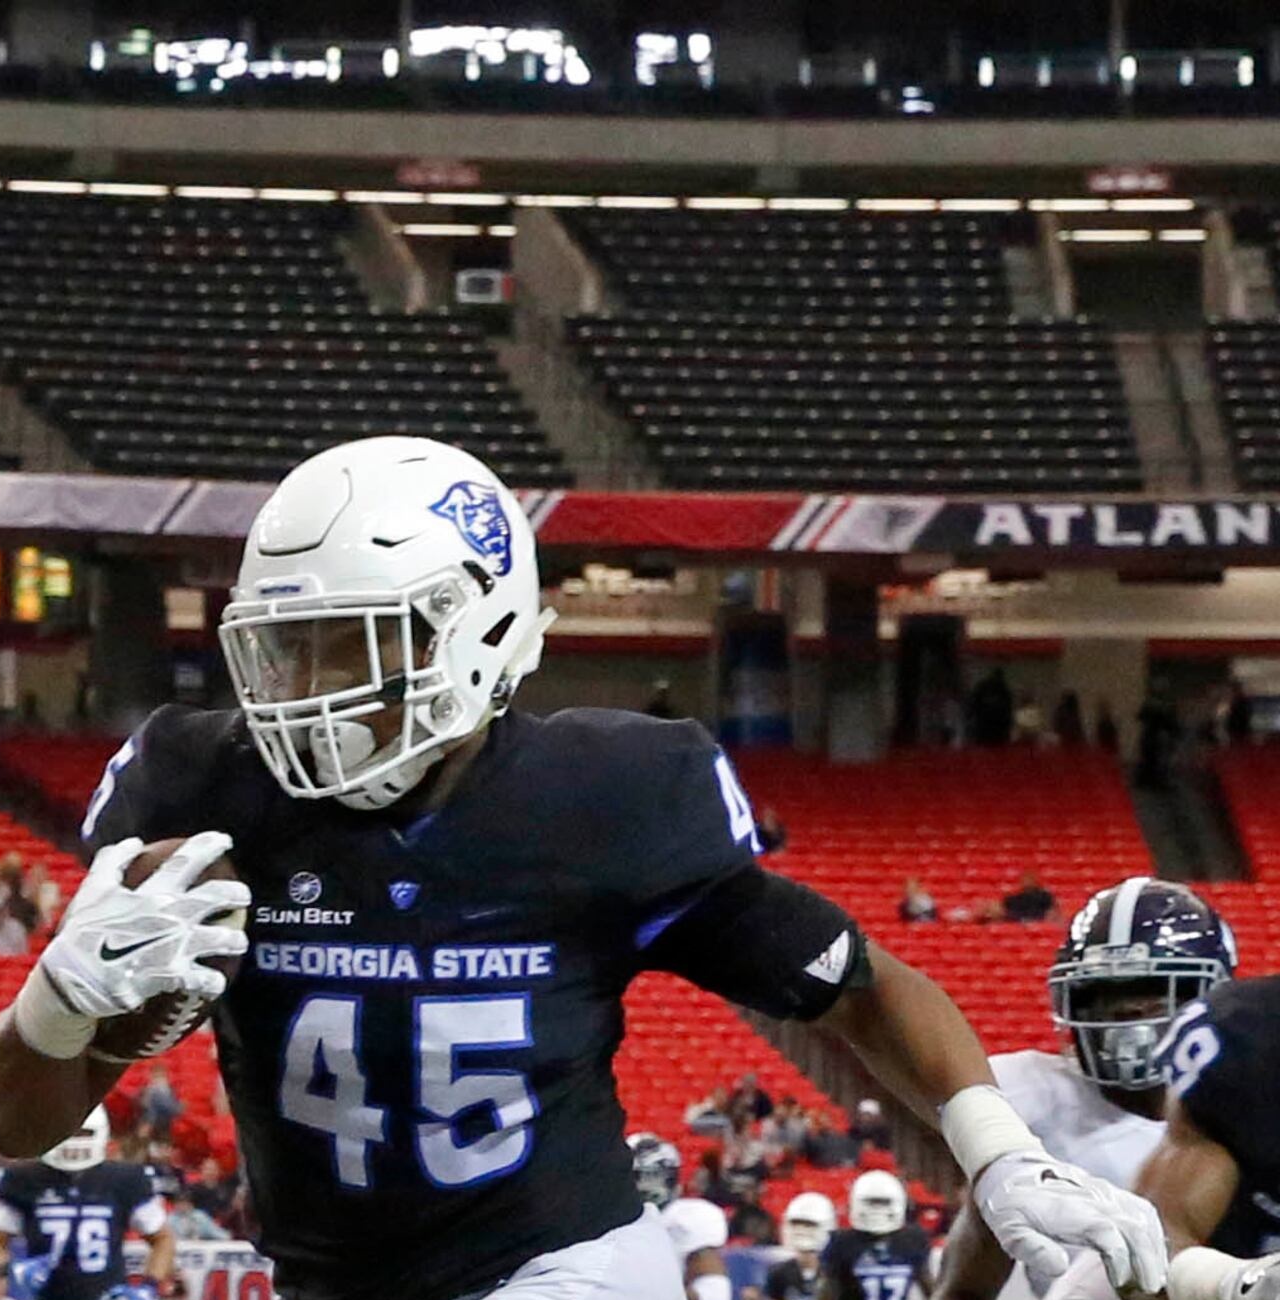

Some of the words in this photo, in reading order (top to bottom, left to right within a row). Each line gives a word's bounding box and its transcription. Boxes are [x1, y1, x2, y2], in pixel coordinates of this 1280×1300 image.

[254, 943, 421, 980] GEORGIA
[431, 943, 554, 980] STATE
[280, 993, 540, 1189] 45
[39, 1217, 111, 1273] 76
